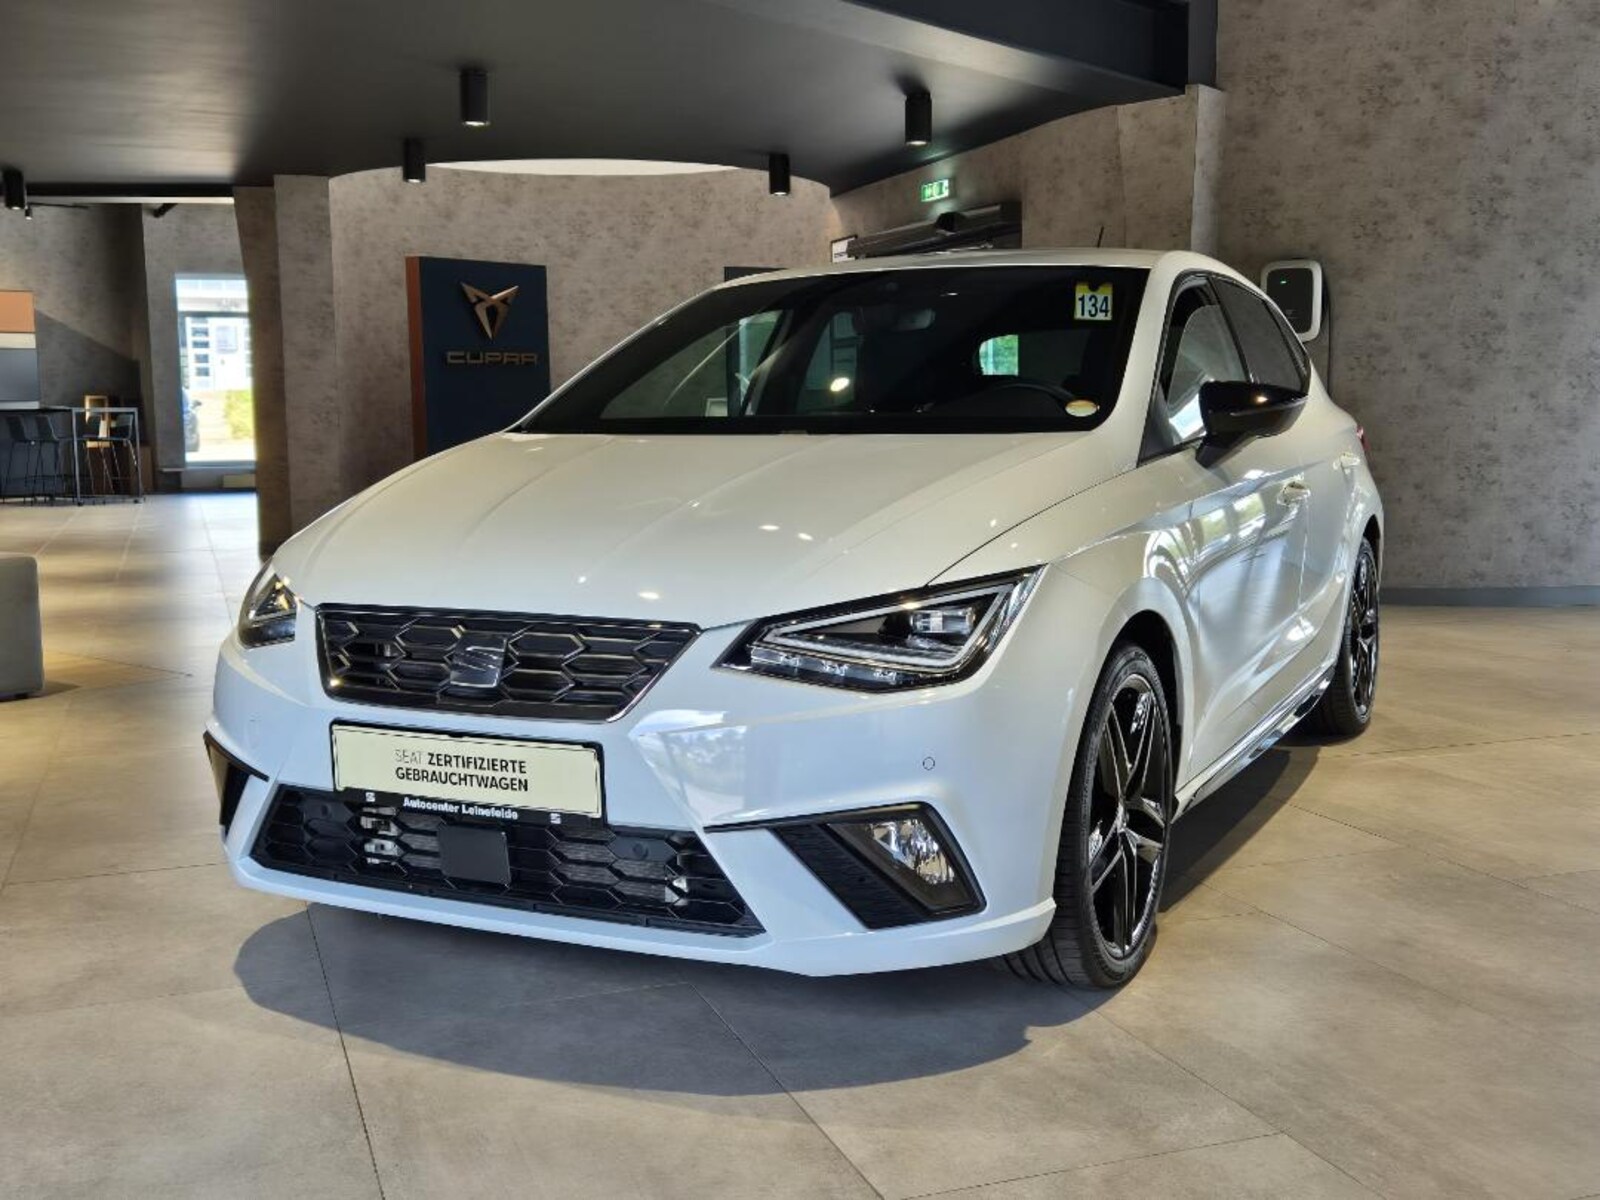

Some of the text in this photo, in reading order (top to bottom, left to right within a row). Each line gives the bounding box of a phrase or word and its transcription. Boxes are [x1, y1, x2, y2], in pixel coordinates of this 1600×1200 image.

[1078, 293, 1110, 318] 134
[447, 351, 538, 366] CUPRA
[394, 749, 527, 774] SEAT ZERTIFIZIERTE
[395, 766, 528, 792] GEBRAUCHTWAGEN
[403, 796, 519, 820] Autocenter Leinefelde
